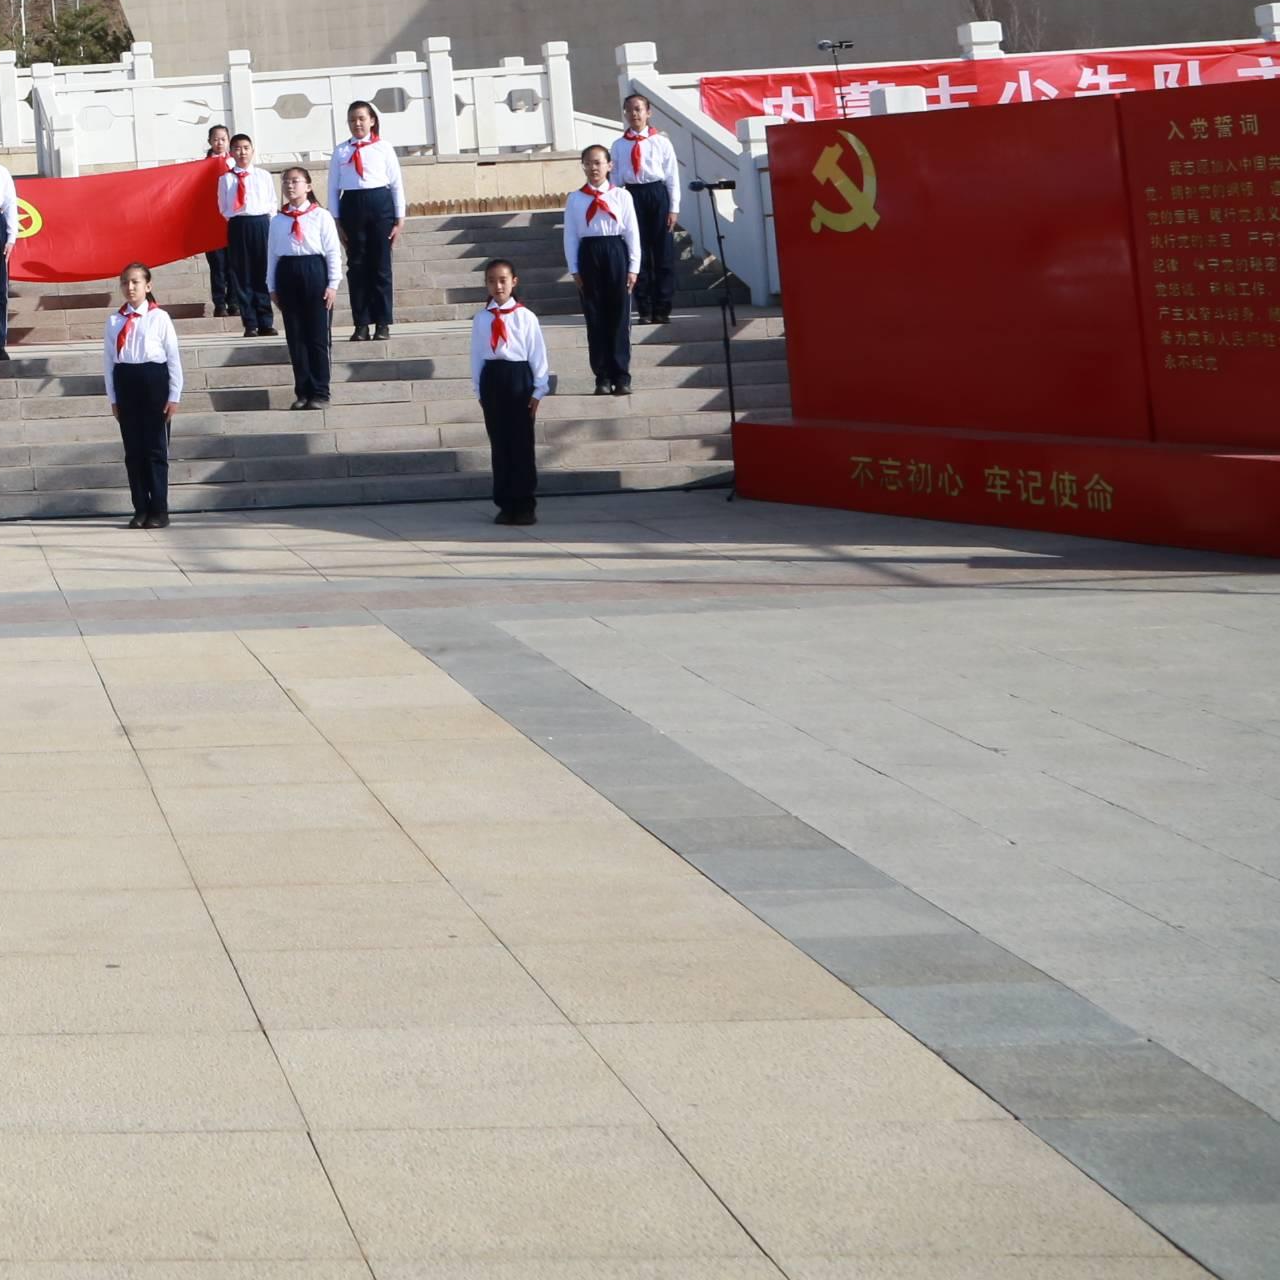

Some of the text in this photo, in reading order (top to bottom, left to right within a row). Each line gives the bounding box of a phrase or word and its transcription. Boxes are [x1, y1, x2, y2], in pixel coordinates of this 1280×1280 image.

[1168, 113, 1259, 140] 入党誓词
[850, 456, 1114, 512] 不忘初心 牢记使命
